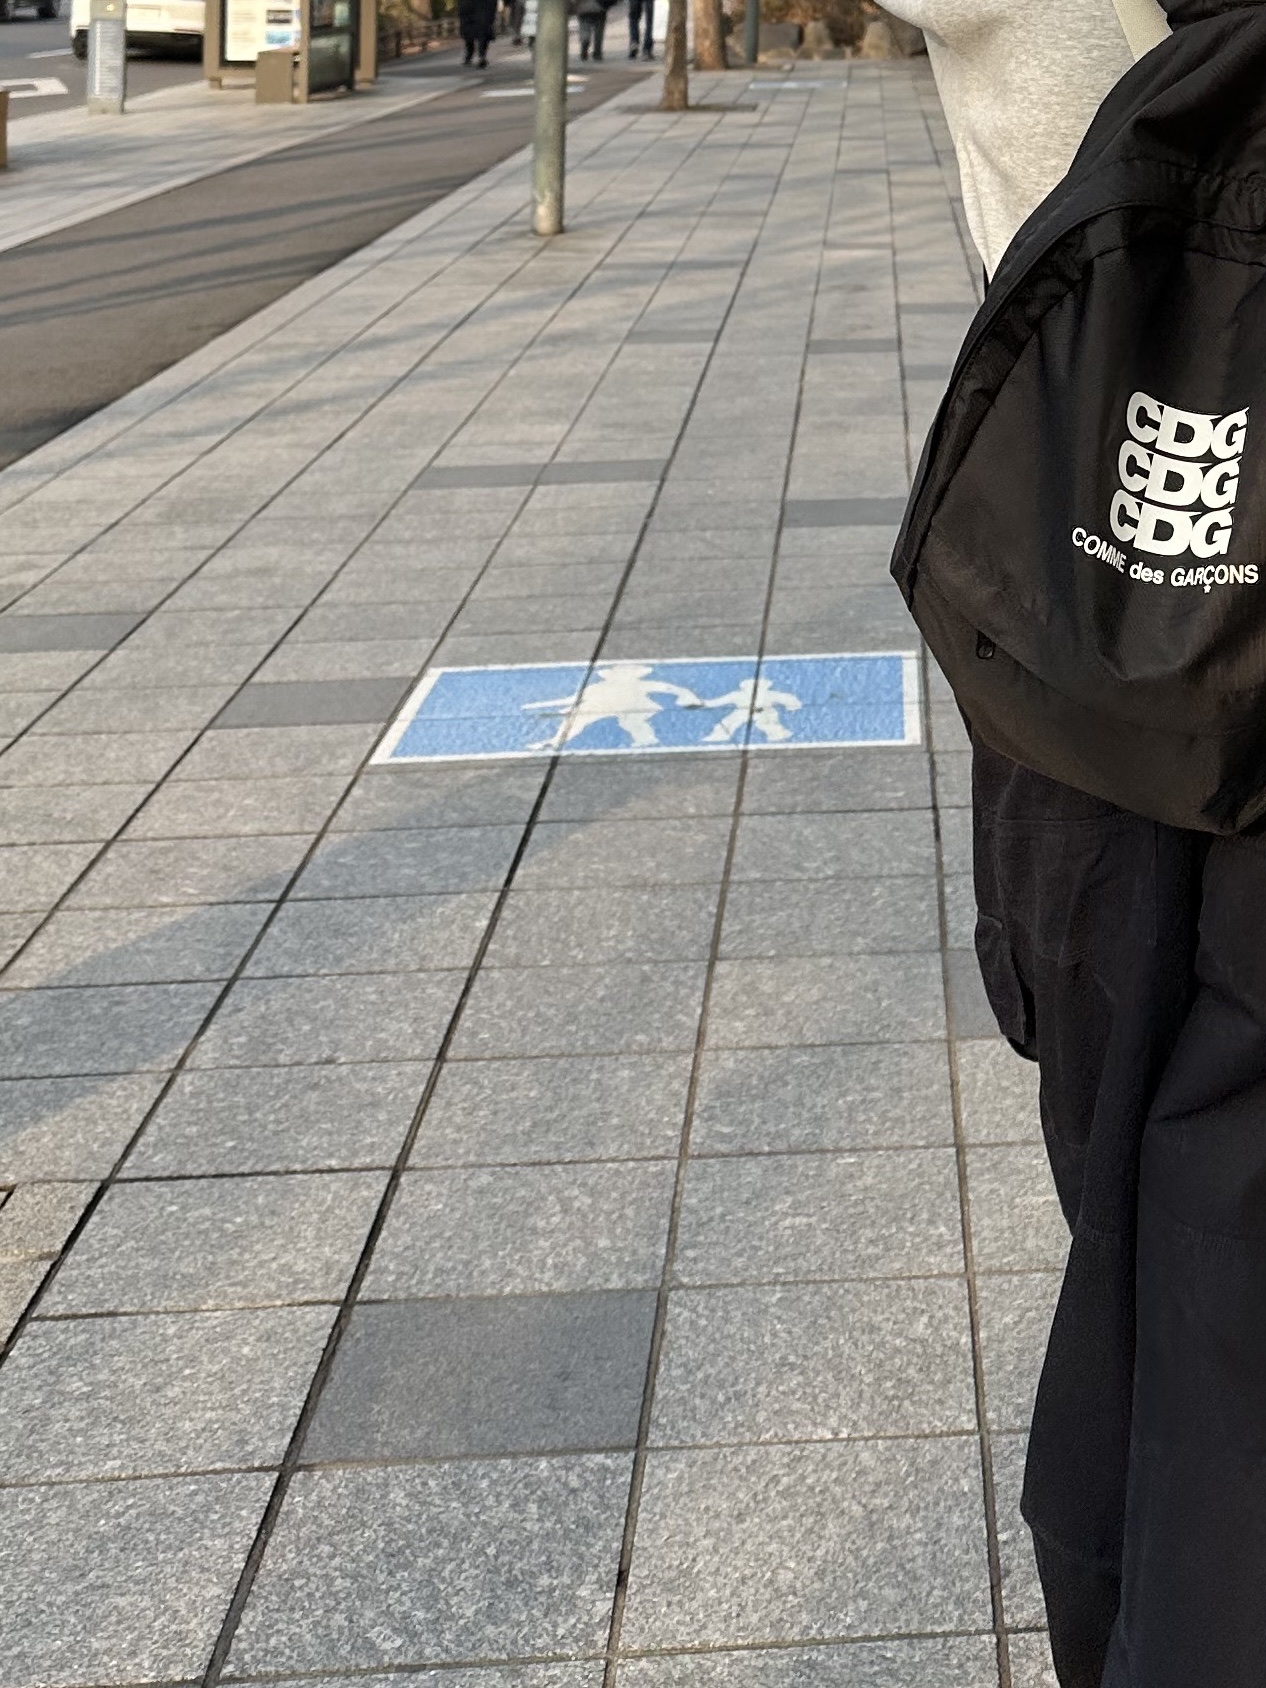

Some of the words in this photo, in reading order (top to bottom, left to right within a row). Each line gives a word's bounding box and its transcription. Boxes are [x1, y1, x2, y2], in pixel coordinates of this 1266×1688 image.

[1126, 391, 1250, 460] CDG
[1118, 439, 1243, 509] CDG
[1109, 489, 1236, 559] CDG
[1071, 526, 1127, 574] COMME
[1129, 561, 1164, 585] des
[1170, 563, 1260, 594] GARÇONS
